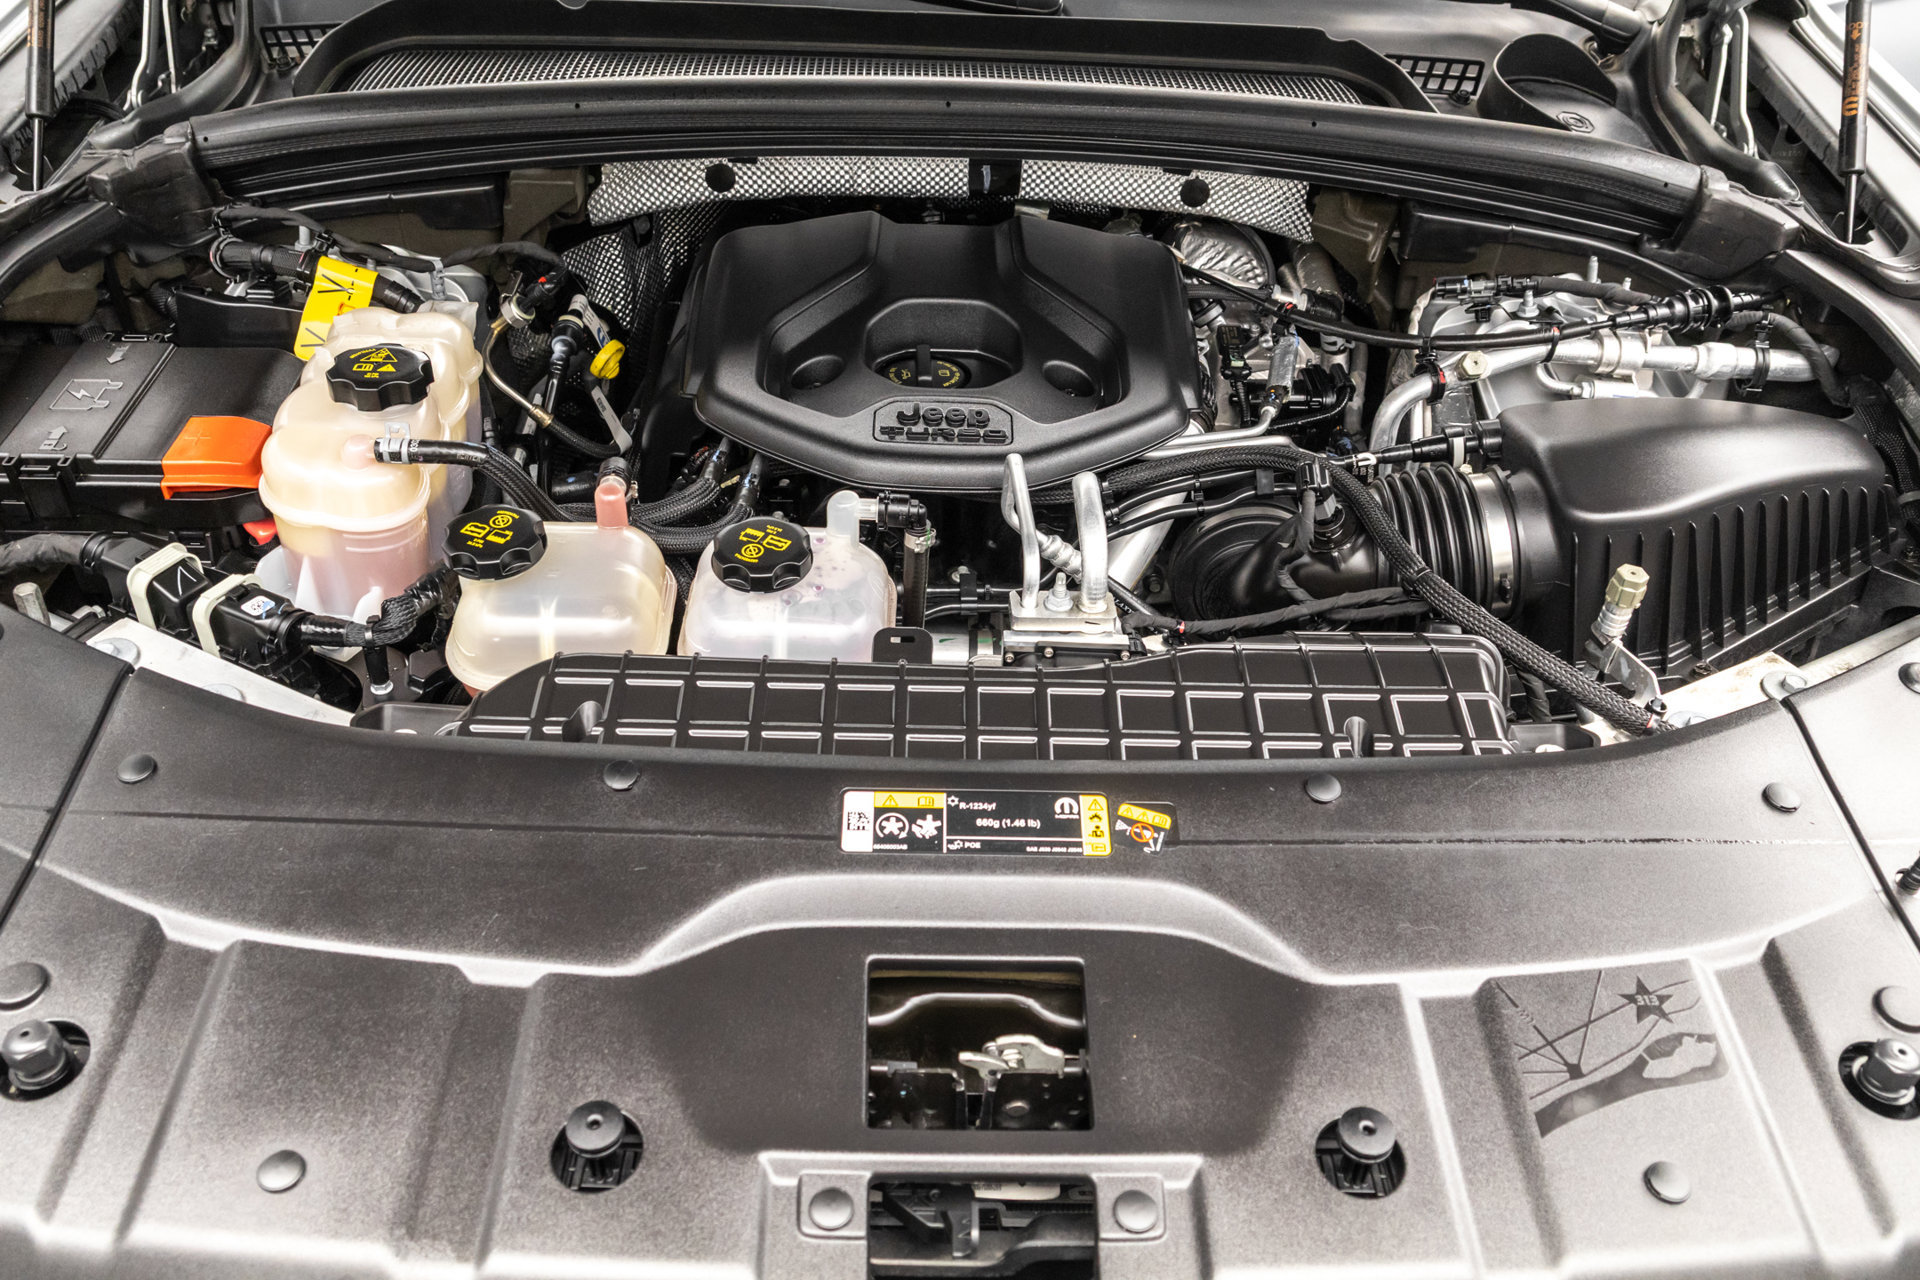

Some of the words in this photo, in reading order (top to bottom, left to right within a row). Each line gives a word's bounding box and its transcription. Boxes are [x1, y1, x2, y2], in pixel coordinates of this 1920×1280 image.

[896, 402, 991, 429] Jeep
[879, 425, 1009, 444] TURBO
[959, 801, 997, 812] R-1234yf
[1027, 819, 1041, 829] lb)
[964, 841, 982, 850] POE
[1633, 994, 1661, 1006] 313
